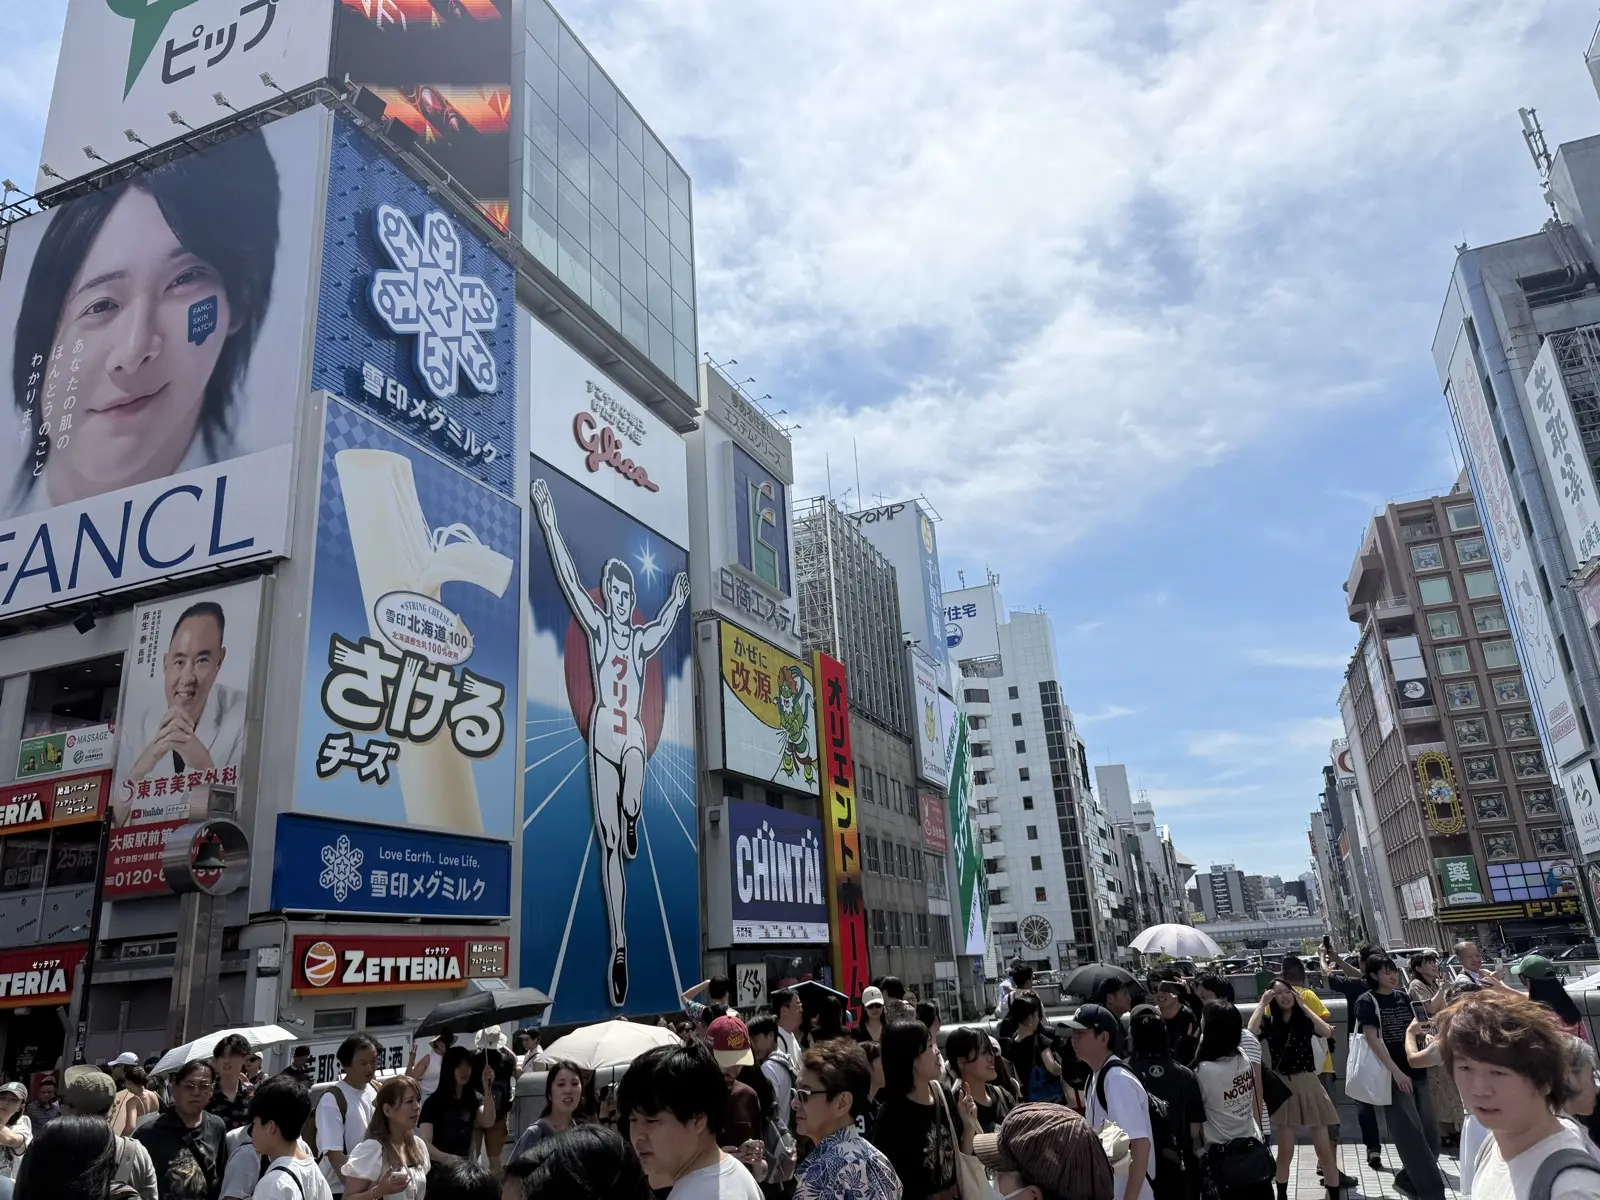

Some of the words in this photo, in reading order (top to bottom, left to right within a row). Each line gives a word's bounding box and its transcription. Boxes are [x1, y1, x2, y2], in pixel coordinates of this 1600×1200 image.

[162, 0, 279, 84] ピップ
[192, 302, 214, 315] FANCL
[192, 313, 209, 325] SKIN
[192, 321, 213, 335] PATCH
[18, 353, 43, 444] わかります
[56, 338, 84, 450] あなたの肌の
[32, 346, 64, 477] ほんとうのこと
[362, 361, 498, 464] 雪印メグミルク
[572, 411, 660, 493] Glico
[724, 407, 782, 469] エステムシリーズ
[850, 504, 905, 527] YOMP
[404, 600, 428, 614] STRING
[428, 605, 451, 626] CHEESE
[733, 636, 768, 669] かぜに
[323, 635, 505, 757] さける
[611, 653, 628, 735] グリコ
[730, 658, 774, 705] 改源
[77, 730, 109, 745] MASSAGE
[317, 733, 400, 784] チーズ
[57, 782, 97, 796] 絶品バーガー
[137, 765, 238, 800] 東京美容外科
[12, 793, 38, 803] ゼッテリア
[55, 797, 87, 807] フェアトレード
[67, 804, 95, 815] コーヒー
[142, 807, 164, 818] YouTube
[379, 846, 403, 861] Love
[405, 849, 435, 864] Earth.
[439, 853, 459, 867] Love
[461, 855, 480, 868] Life.
[736, 820, 823, 905] CHINTAI
[370, 869, 486, 902] 雪印メグミルク
[425, 947, 450, 956] ゼッテリア
[472, 944, 503, 954] 絶品バーガー
[32, 959, 61, 969] ゼッテリア
[342, 950, 462, 984] ZETTERIA
[481, 965, 502, 974] コーヒー
